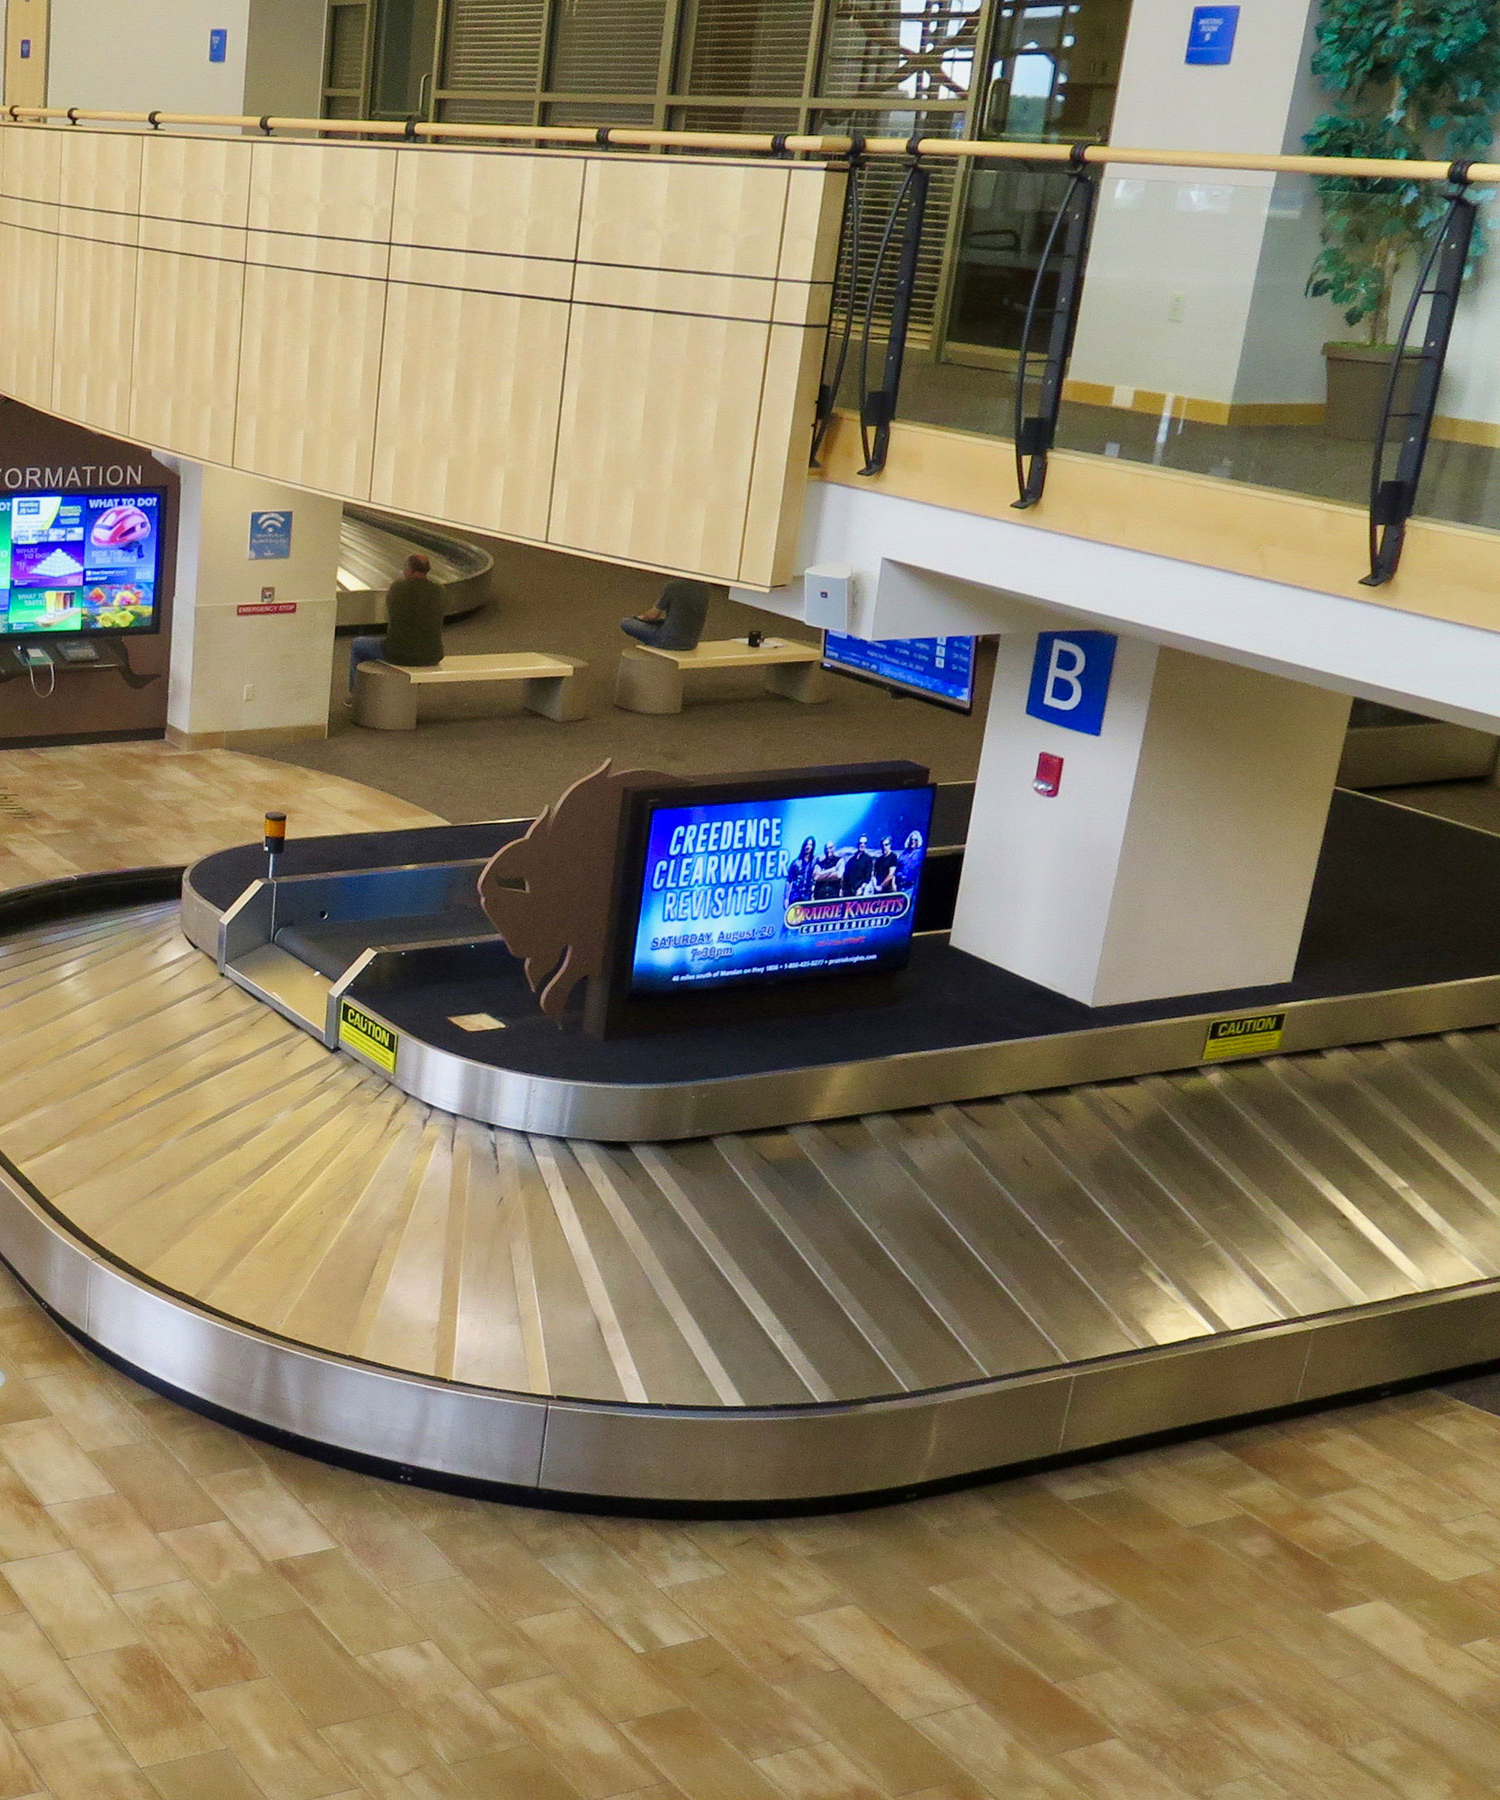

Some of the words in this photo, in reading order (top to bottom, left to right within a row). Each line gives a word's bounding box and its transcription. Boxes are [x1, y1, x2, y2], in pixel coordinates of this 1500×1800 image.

[89, 498, 120, 508] WHAT
[121, 497, 135, 507] TO
[137, 496, 157, 507] DO?
[238, 604, 278, 613] EMERGENCY
[279, 603, 296, 612] STOP
[1043, 638, 1086, 711] B
[669, 818, 782, 856] CREEDENCE
[652, 850, 790, 889] CLEARWATER
[664, 883, 772, 921] REVISITED
[794, 903, 843, 925] PRAIRIE
[843, 898, 905, 919] KNIGHTS
[651, 932, 714, 950] SATURDAY,
[716, 928, 757, 945] August
[758, 926, 776, 940] 20
[802, 922, 841, 934] CASINO
[851, 918, 888, 929] RESORT
[720, 968, 743, 977] Mandan
[347, 1008, 390, 1047] CAUTION
[1218, 1016, 1277, 1037] CAUTION
